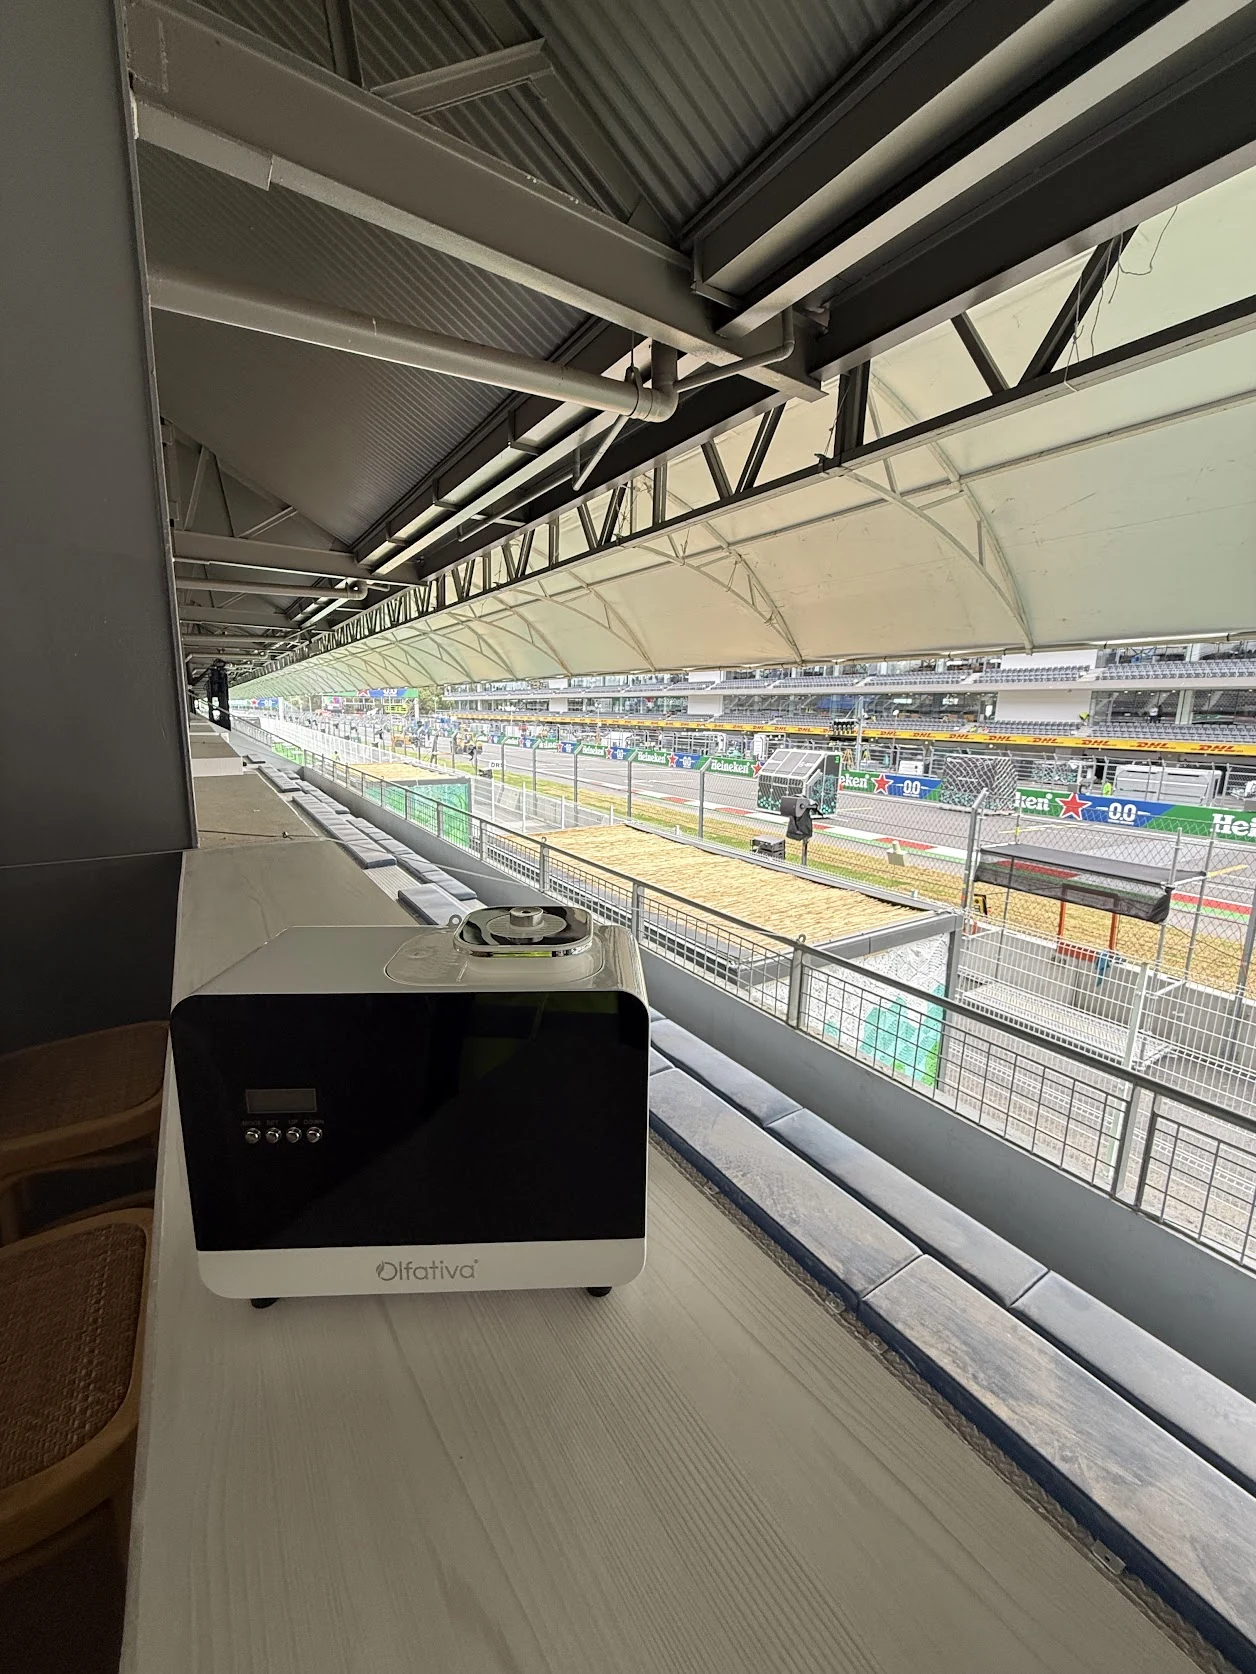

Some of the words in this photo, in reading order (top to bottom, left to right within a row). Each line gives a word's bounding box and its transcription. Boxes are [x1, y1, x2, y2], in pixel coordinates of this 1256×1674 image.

[1198, 744, 1236, 753] DHL
[638, 752, 667, 764] Heineken
[711, 760, 750, 774] Heineken
[1013, 791, 1051, 811] ken
[1108, 802, 1137, 822] 0.0
